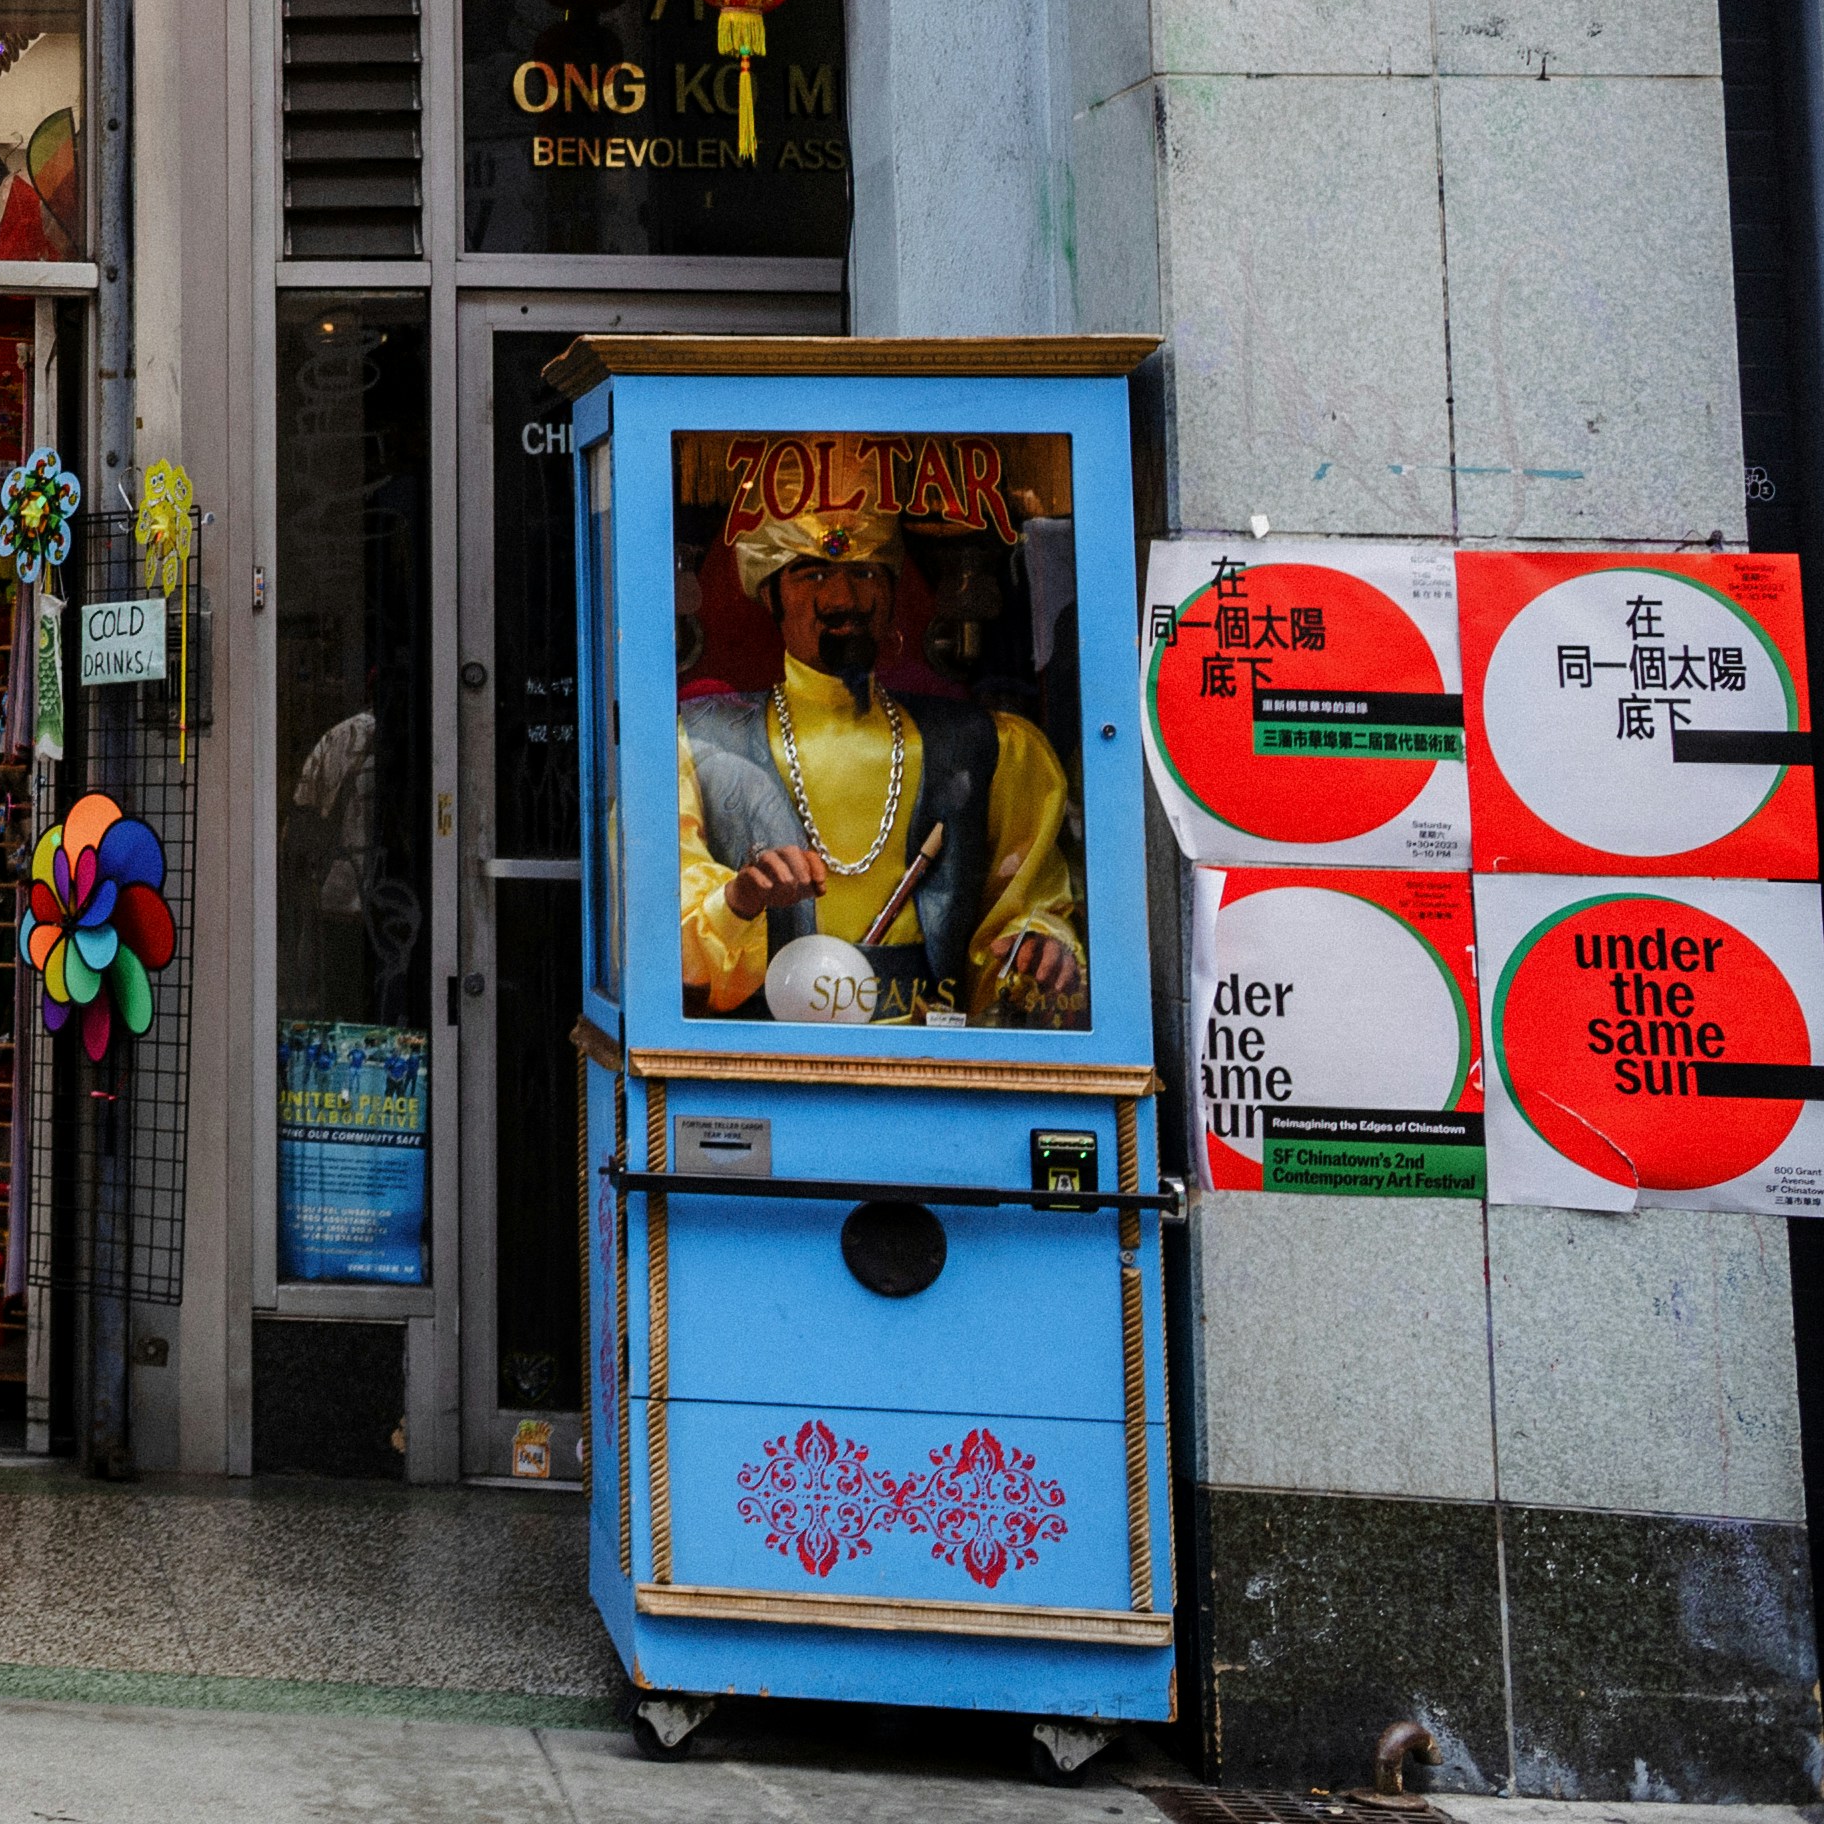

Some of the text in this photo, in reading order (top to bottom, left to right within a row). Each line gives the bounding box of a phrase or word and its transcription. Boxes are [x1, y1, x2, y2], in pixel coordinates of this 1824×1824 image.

[513, 60, 646, 115] ONG
[778, 138, 848, 170] ASS
[725, 436, 1019, 547] ZOLTAR
[1210, 555, 1247, 602] 在
[89, 606, 145, 641] COLD
[1150, 603, 1326, 652] 同一個太陽
[1626, 594, 1664, 641] 在
[1199, 654, 1273, 698] 底下
[1555, 643, 1747, 693] 同一個太陽
[1615, 693, 1693, 742] 底下
[1412, 820, 1453, 831] Saturday
[1436, 850, 1452, 858] PM
[1575, 928, 1724, 974] under
[810, 975, 960, 1019] SPEAKS
[1213, 973, 1294, 1018] der
[1608, 974, 1695, 1018] the
[1202, 1018, 1266, 1063] he
[1587, 1017, 1726, 1060] same
[1200, 1065, 1293, 1102] ame
[1614, 1059, 1699, 1097] sun
[282, 1106, 419, 1130] OLLABORATIVE
[359, 1094, 419, 1115] PEACE
[1205, 1103, 1264, 1139] un
[307, 1130, 331, 1140] OUR
[331, 1131, 394, 1144] COMMUNITY
[396, 1135, 422, 1146] SAFE
[1272, 1117, 1466, 1135] Reimagining the Edges of Chinatown
[1272, 1148, 1425, 1170] SF Chinatown's 2nd
[1774, 1166, 1822, 1176] 800 Grant
[1272, 1168, 1476, 1191] Contemporary Art Festival
[1765, 1184, 1824, 1195] SF Chinatow
[1781, 1176, 1816, 1186] Avenue
